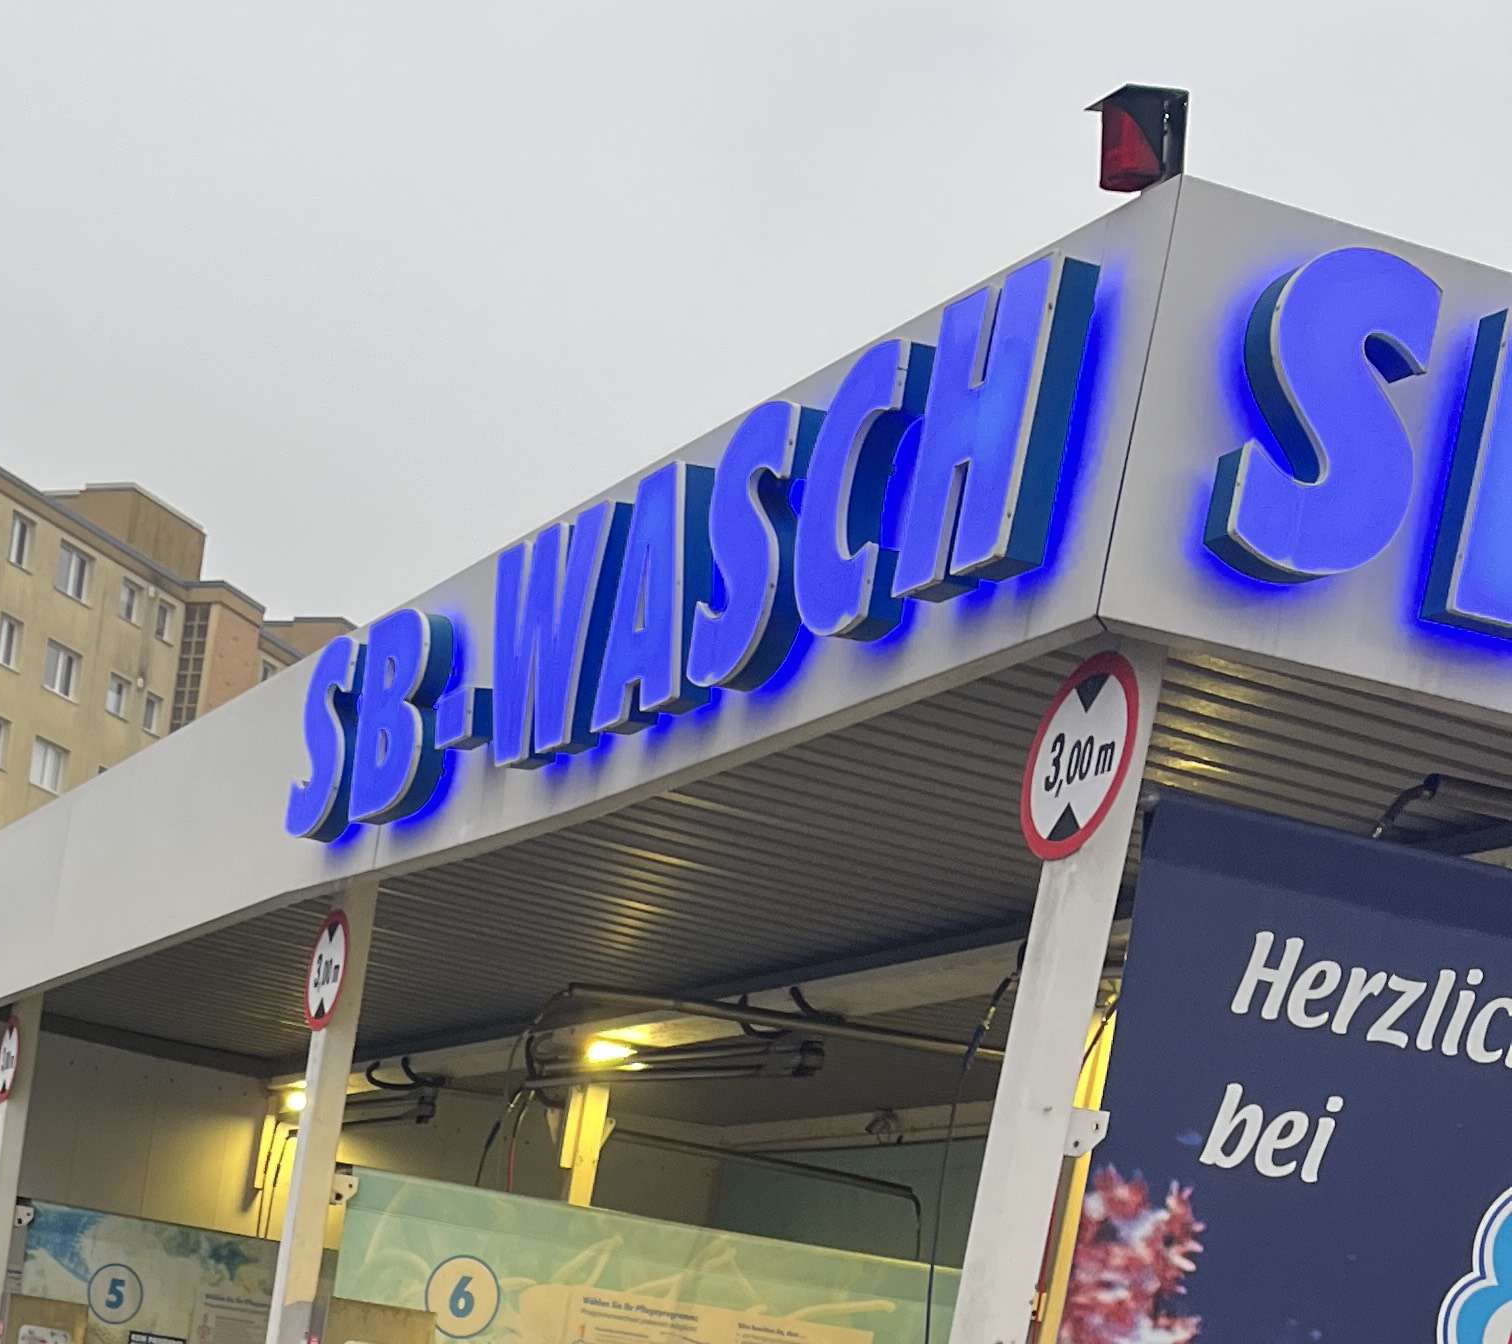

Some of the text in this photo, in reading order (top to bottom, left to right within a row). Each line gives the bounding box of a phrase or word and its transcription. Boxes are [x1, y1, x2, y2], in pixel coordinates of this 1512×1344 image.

[288, 250, 1098, 846] SB-WASCH
[1044, 733, 1116, 798] 3,00 m
[1231, 931, 1512, 1068] Herzlic
[1199, 1082, 1344, 1183] bei
[105, 1278, 125, 1310] 5
[449, 1276, 474, 1318] 6
